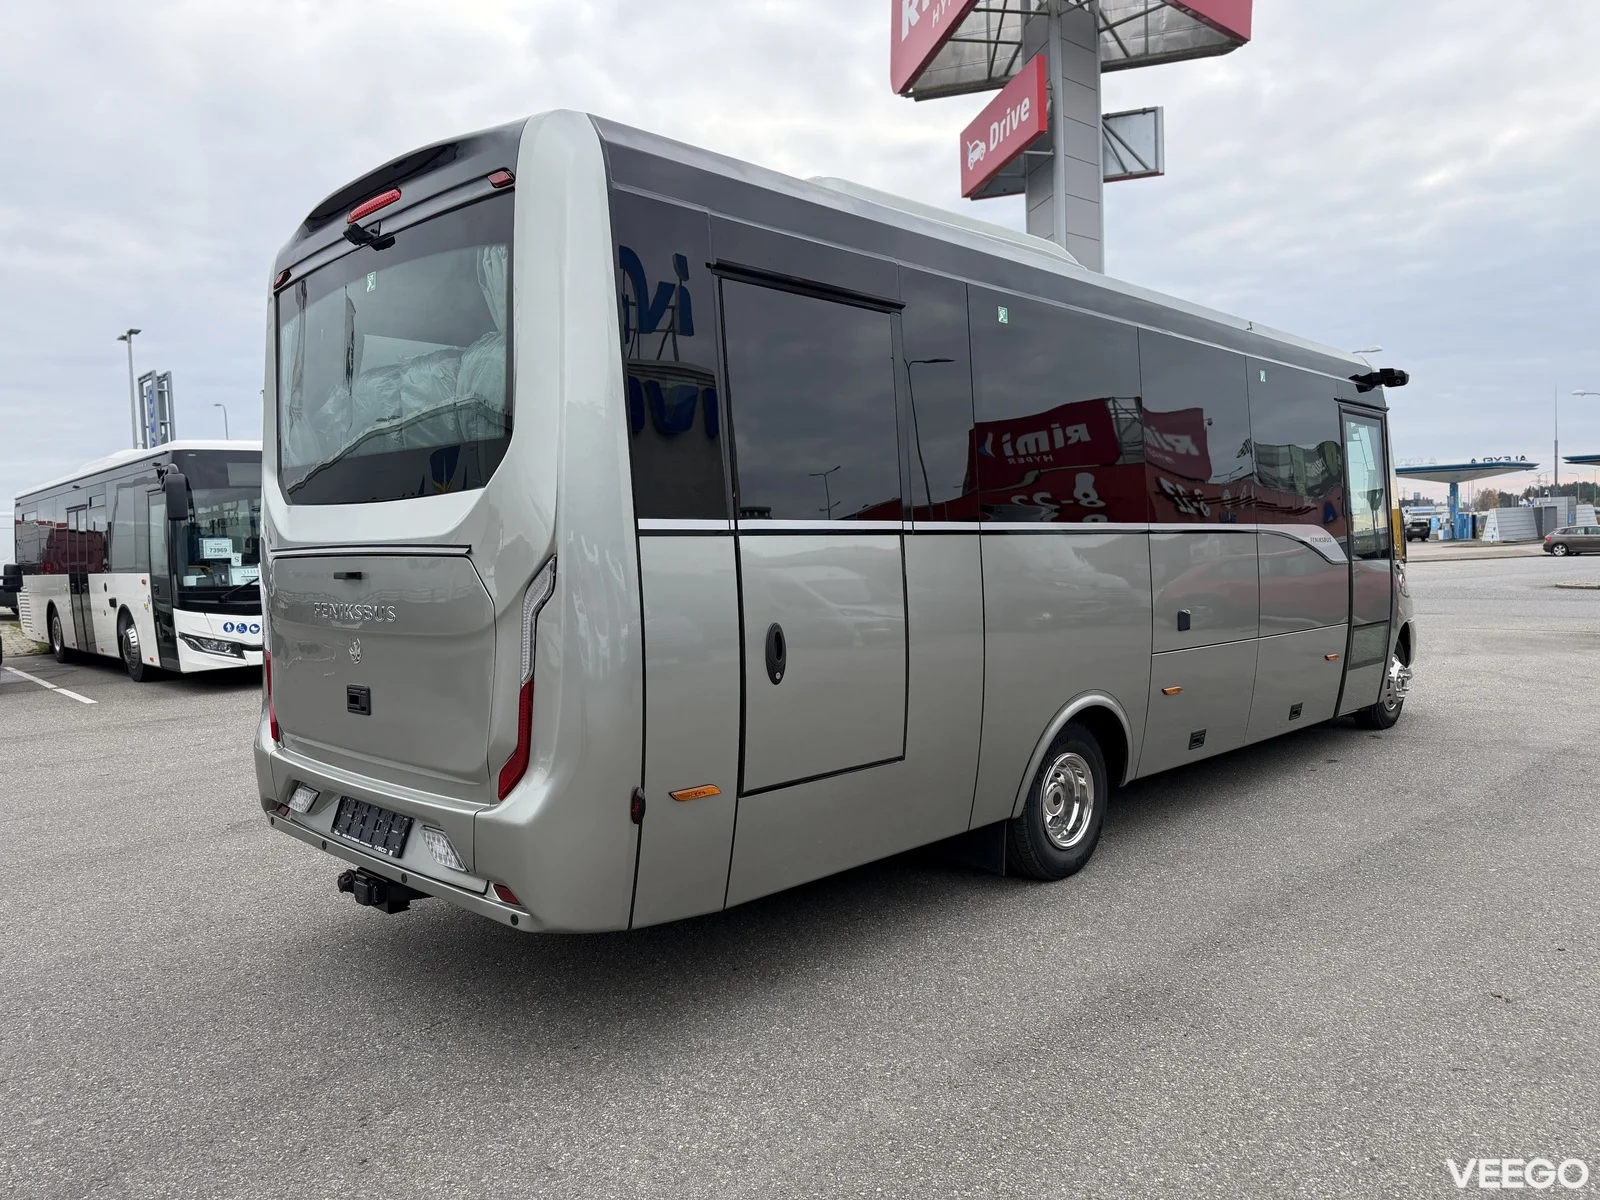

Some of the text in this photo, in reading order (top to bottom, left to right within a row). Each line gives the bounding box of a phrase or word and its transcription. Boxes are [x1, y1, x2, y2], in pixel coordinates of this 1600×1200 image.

[932, 0, 951, 28] HY
[988, 95, 1030, 153] Drive
[313, 602, 397, 624] FENIKSBUS
